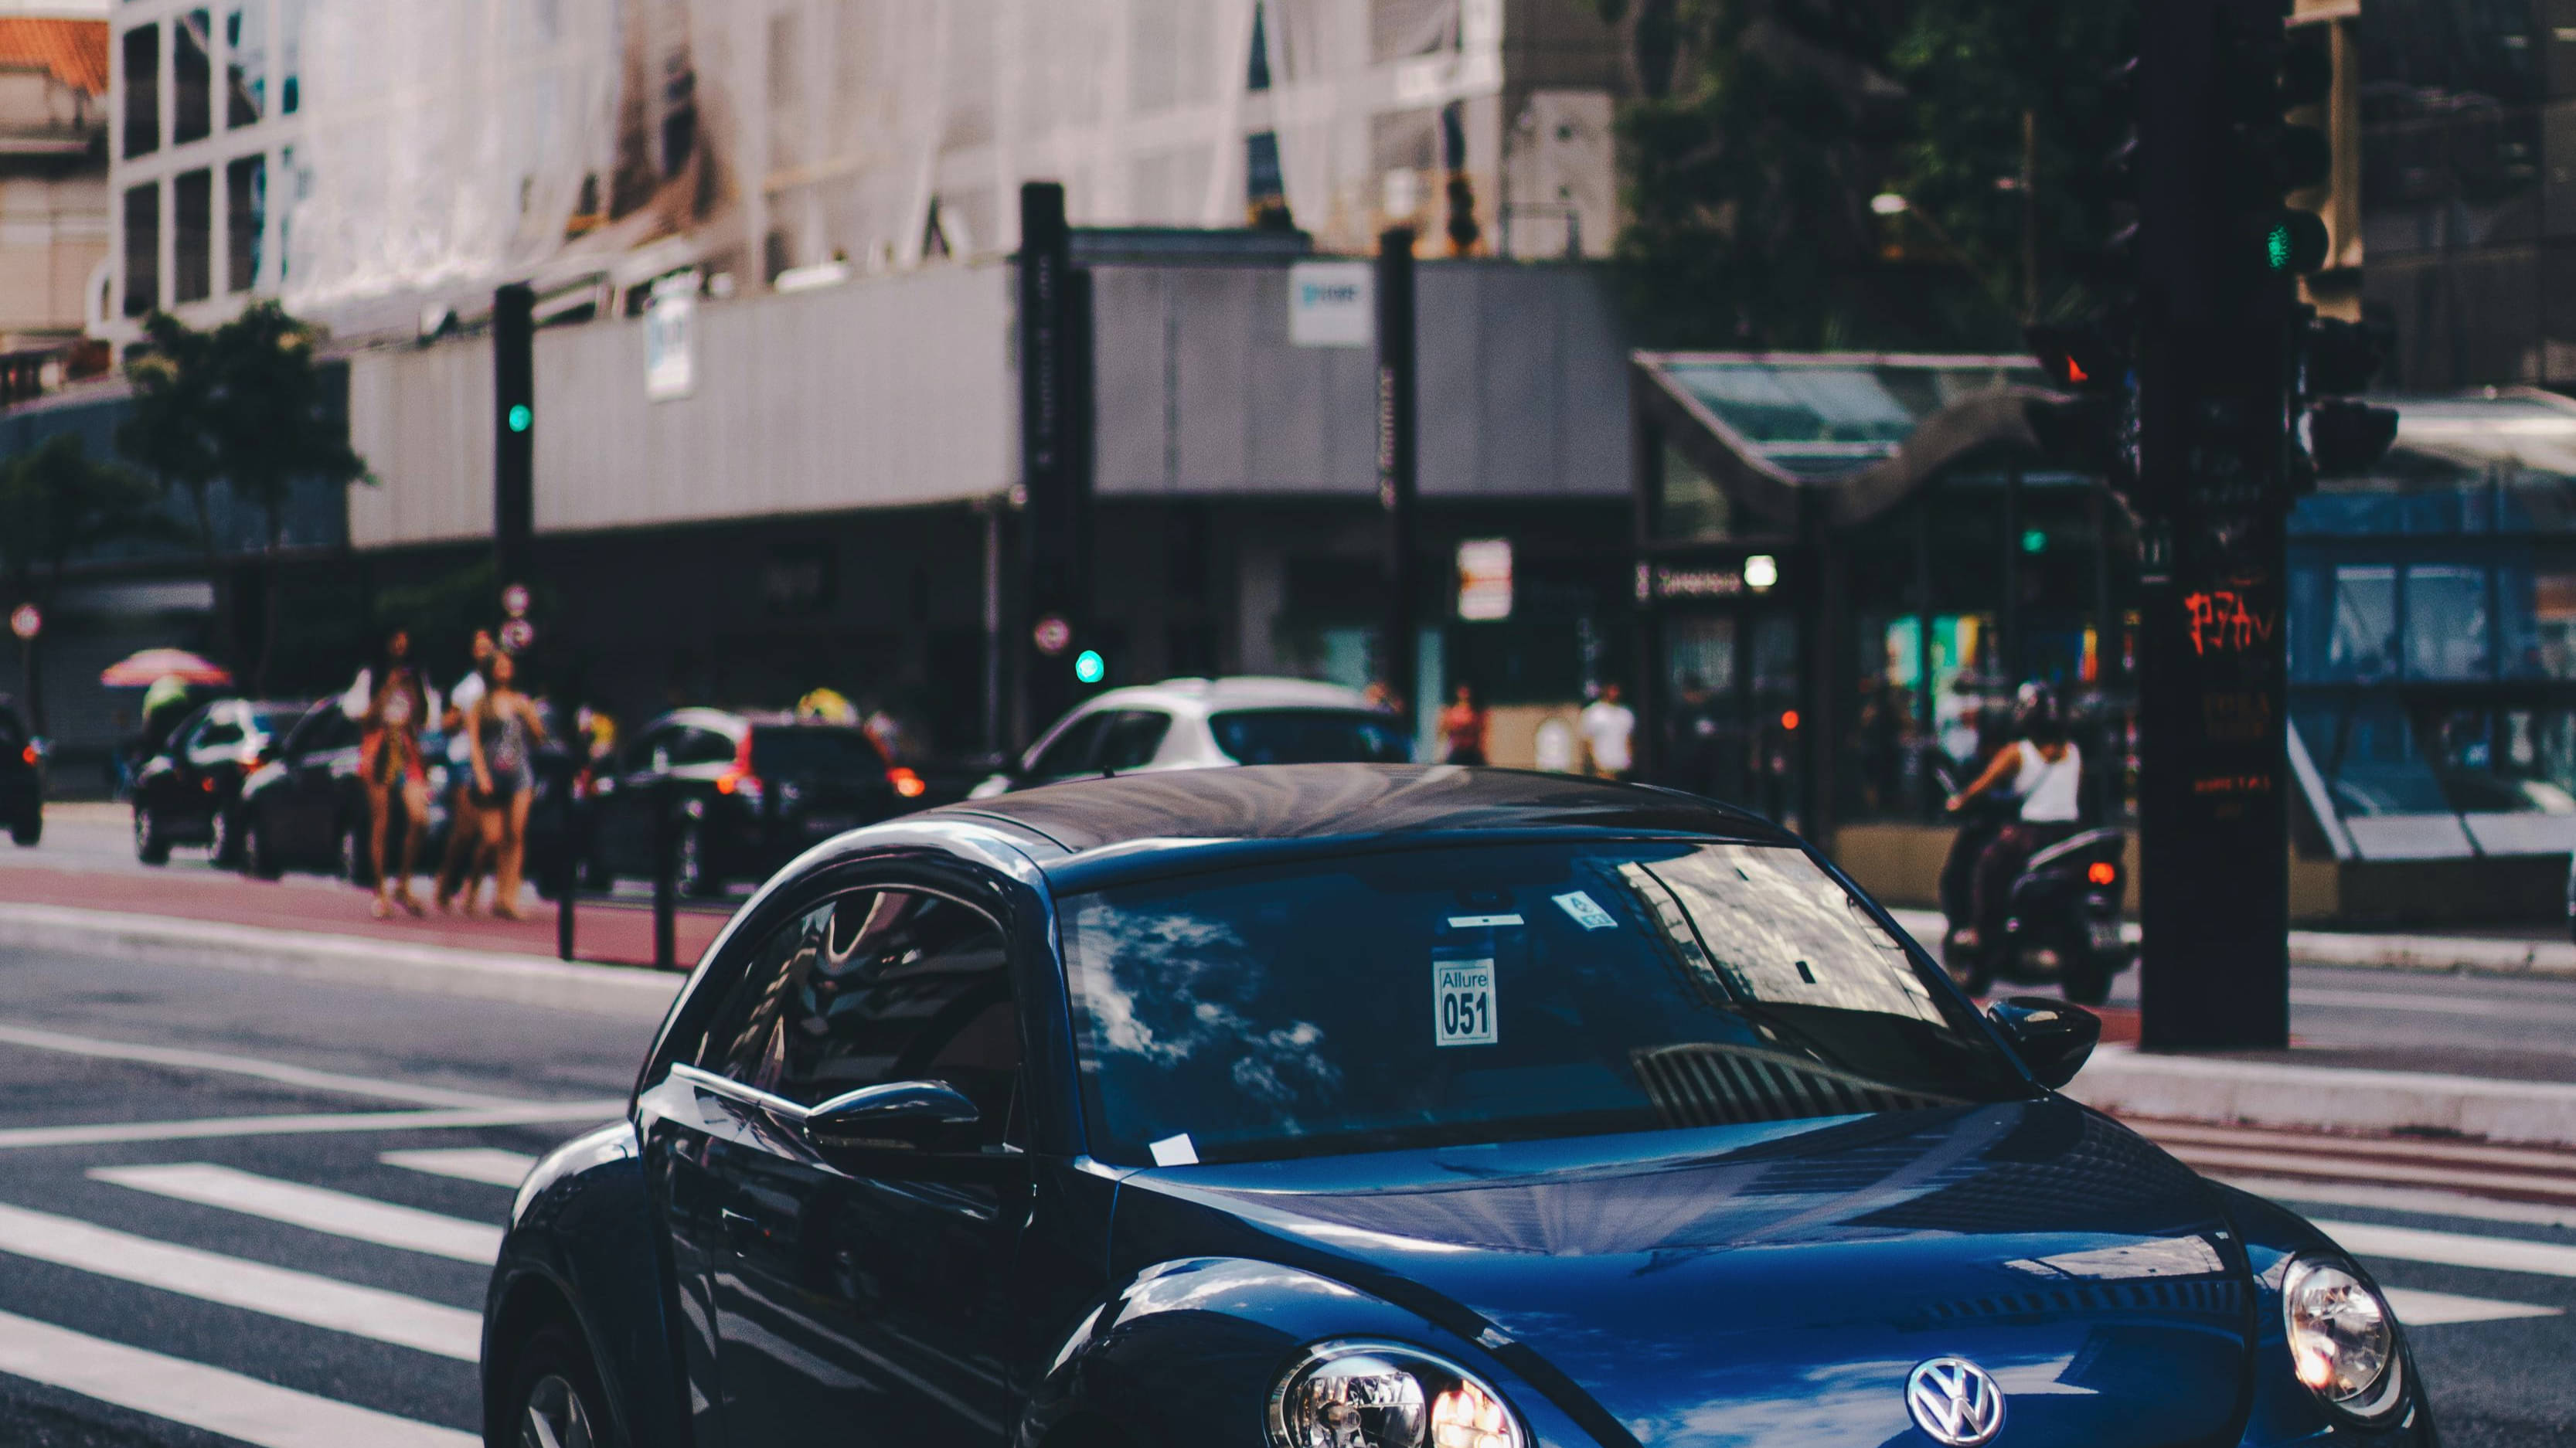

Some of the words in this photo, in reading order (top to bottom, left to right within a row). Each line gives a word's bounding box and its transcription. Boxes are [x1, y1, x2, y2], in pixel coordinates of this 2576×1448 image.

[1442, 971, 1488, 988] Allure
[1444, 991, 1488, 1035] 051
[1911, 1360, 1996, 1443] VW
